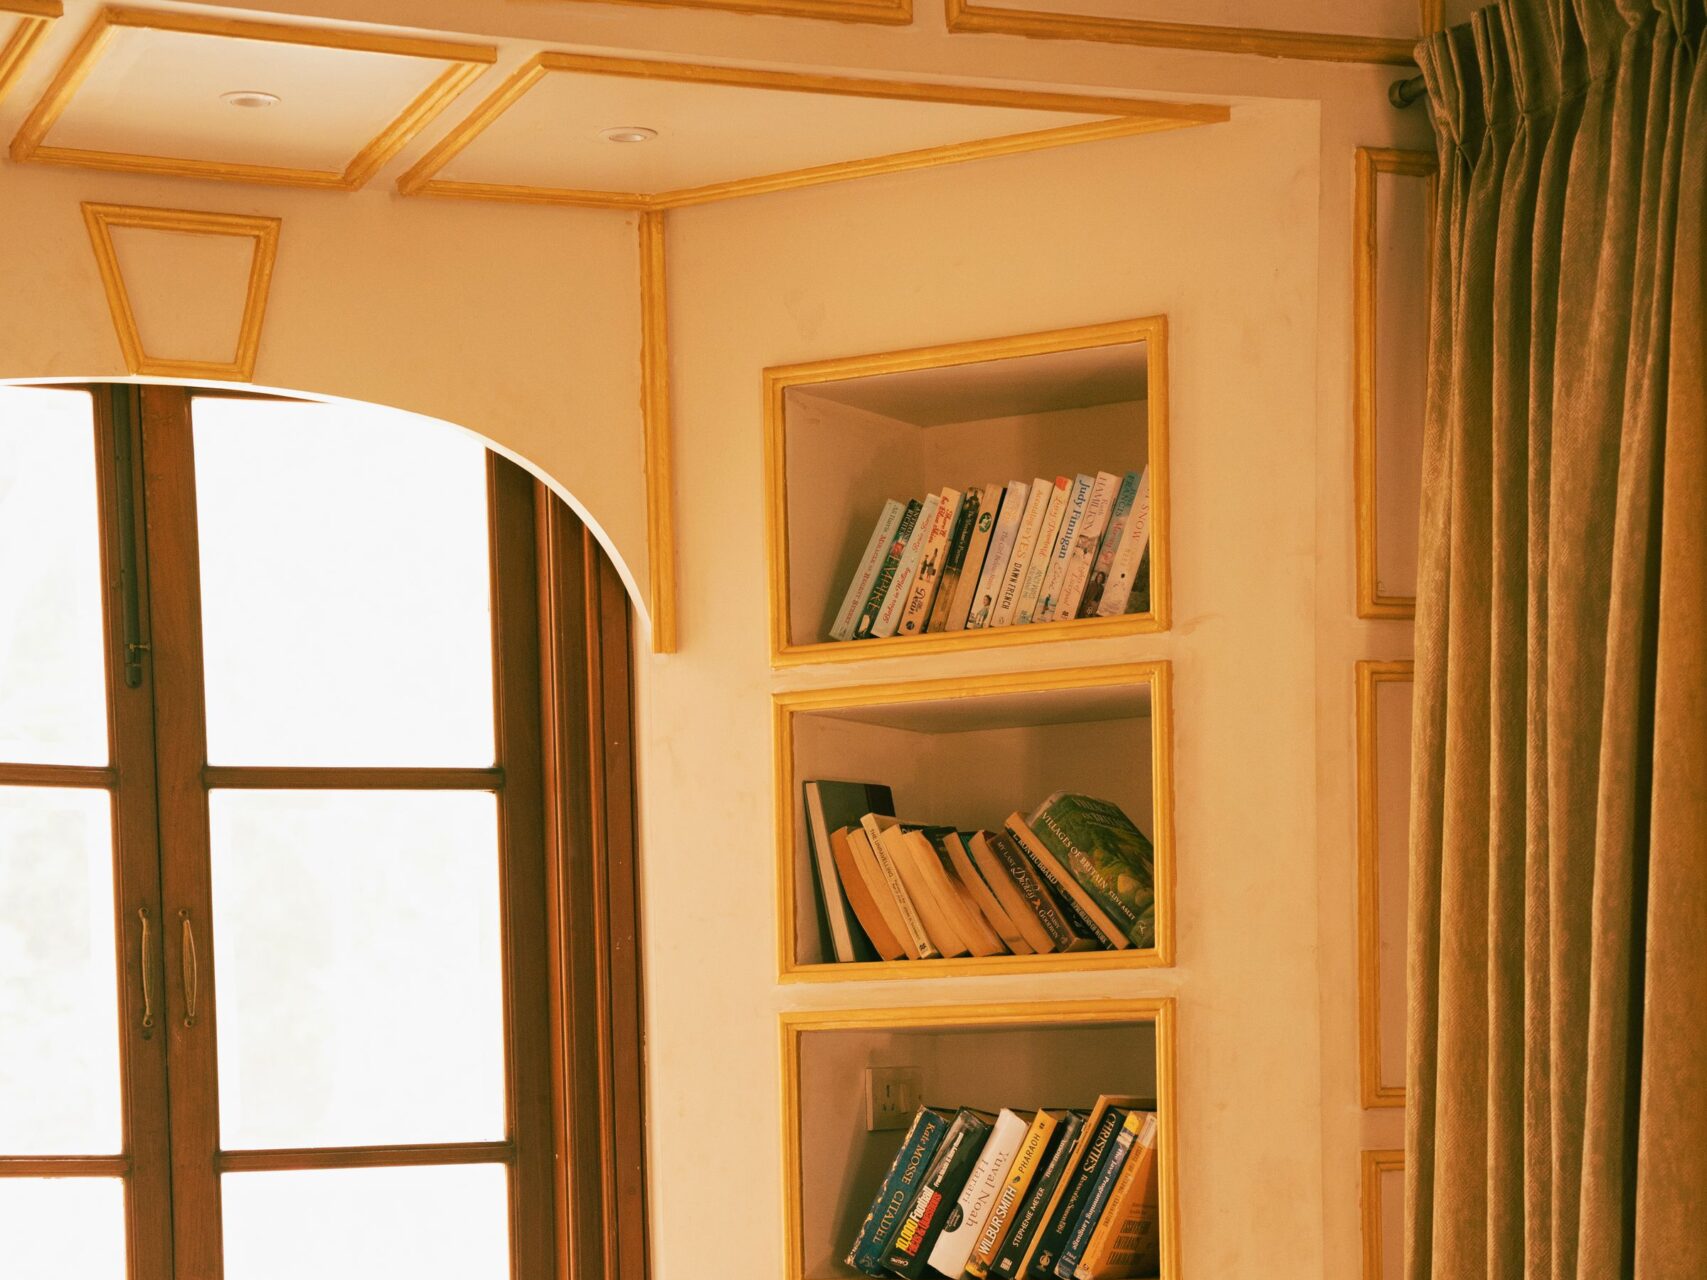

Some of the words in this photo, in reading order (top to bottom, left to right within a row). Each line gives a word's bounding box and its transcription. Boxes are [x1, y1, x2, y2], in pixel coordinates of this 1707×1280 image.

[1072, 479, 1091, 508] Judy
[1082, 476, 1107, 531] HAMILTON
[1115, 474, 1135, 517] FRANCIS
[897, 508, 913, 537] RICHES
[1055, 508, 1081, 560] Finnigan
[1131, 503, 1149, 541] SNOW
[1015, 532, 1031, 559] YES
[865, 553, 900, 613] EMPIRE
[1009, 561, 1022, 583] DAWN
[1001, 582, 1016, 610] FRENCH
[1002, 850, 1015, 867] LAST
[1028, 851, 1058, 885] HUBBARD
[1040, 811, 1073, 847] VILLAGES
[1069, 845, 1082, 858] OF
[1078, 856, 1108, 888] BRITAIN
[1107, 889, 1123, 906] CLIVE
[1120, 903, 1136, 921] ASLET
[918, 1121, 936, 1145] Kate
[1017, 1132, 1041, 1173] PHARAOH
[1081, 1110, 1118, 1174] CHRISTIE'S
[900, 1143, 925, 1185] MOSSE
[961, 1158, 989, 1205] Harari
[984, 1148, 1009, 1188] Yuval
[1106, 1159, 1117, 1175] Java
[871, 1188, 905, 1246] CITADEL
[964, 1188, 990, 1228] Noah
[1011, 1209, 1034, 1247] STEPHENIE
[1029, 1186, 1046, 1211] MEYER
[1084, 1174, 1110, 1219] Programming
[894, 1218, 921, 1252] 10,000
[908, 1185, 936, 1223] Football
[904, 1232, 924, 1256] Facts
[917, 1191, 945, 1230] Questions
[977, 1215, 1003, 1255] WILBUR
[994, 1184, 1018, 1218] SMITH
[1070, 1217, 1090, 1251] Language
